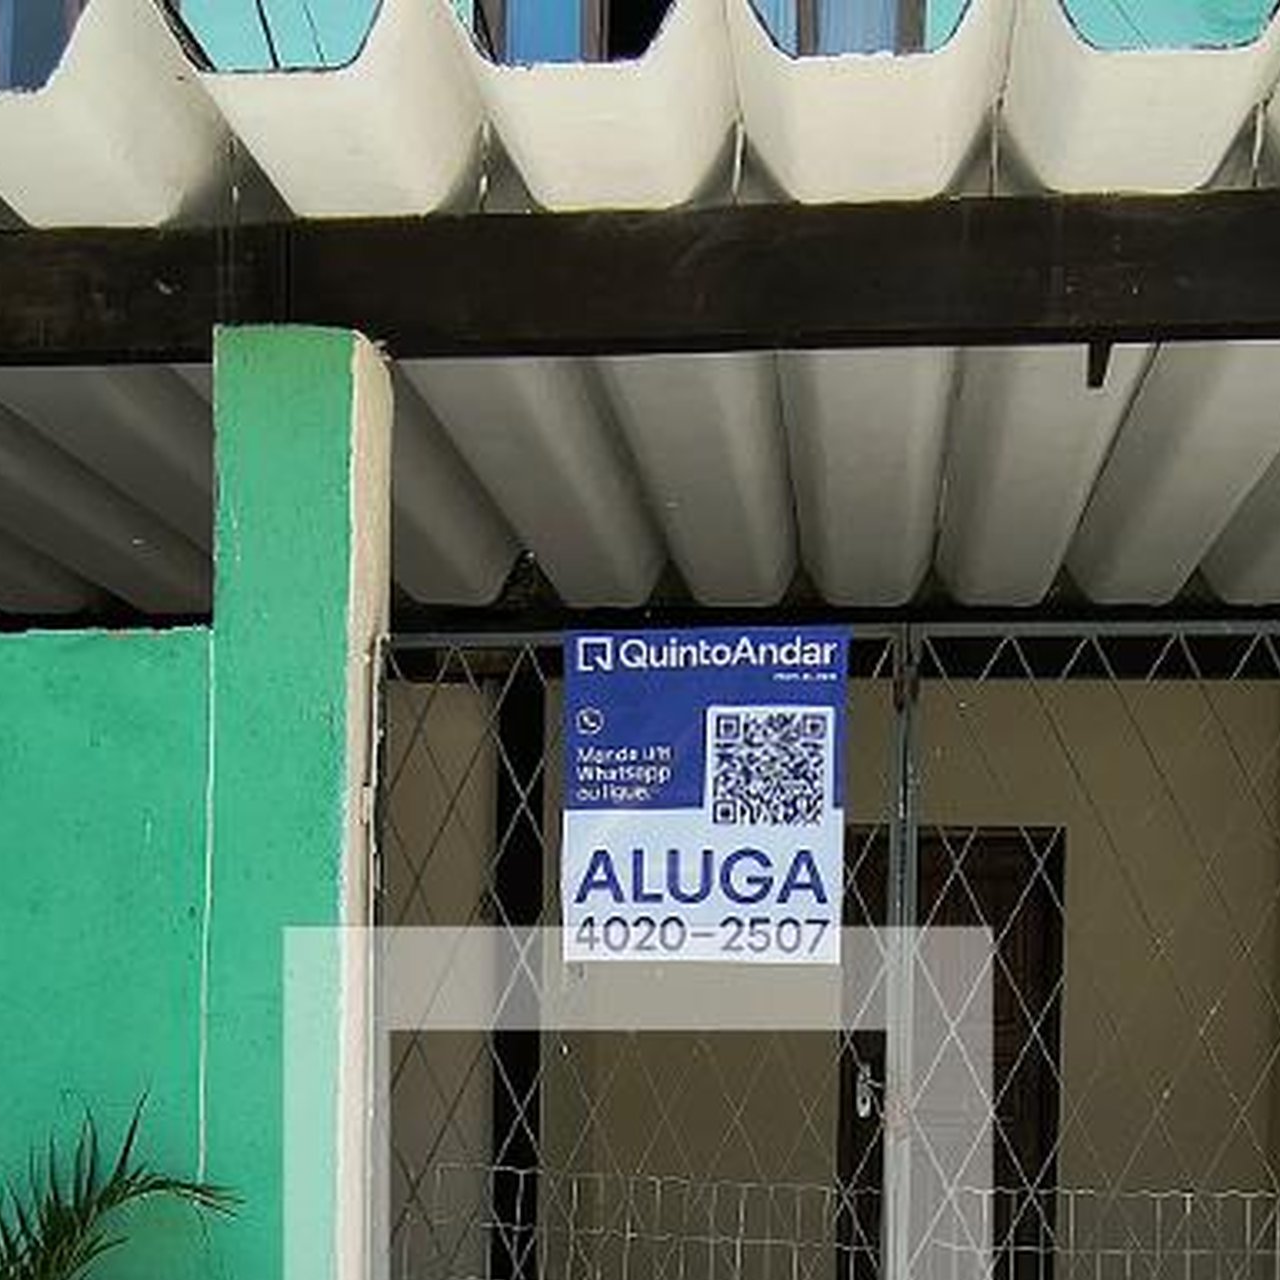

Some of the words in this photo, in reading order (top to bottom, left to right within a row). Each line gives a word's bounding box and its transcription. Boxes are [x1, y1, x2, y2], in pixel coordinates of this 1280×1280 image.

[620, 637, 837, 668] QuintoAndar
[574, 849, 828, 904] ALUGA
[576, 916, 830, 952] 4020-2507
